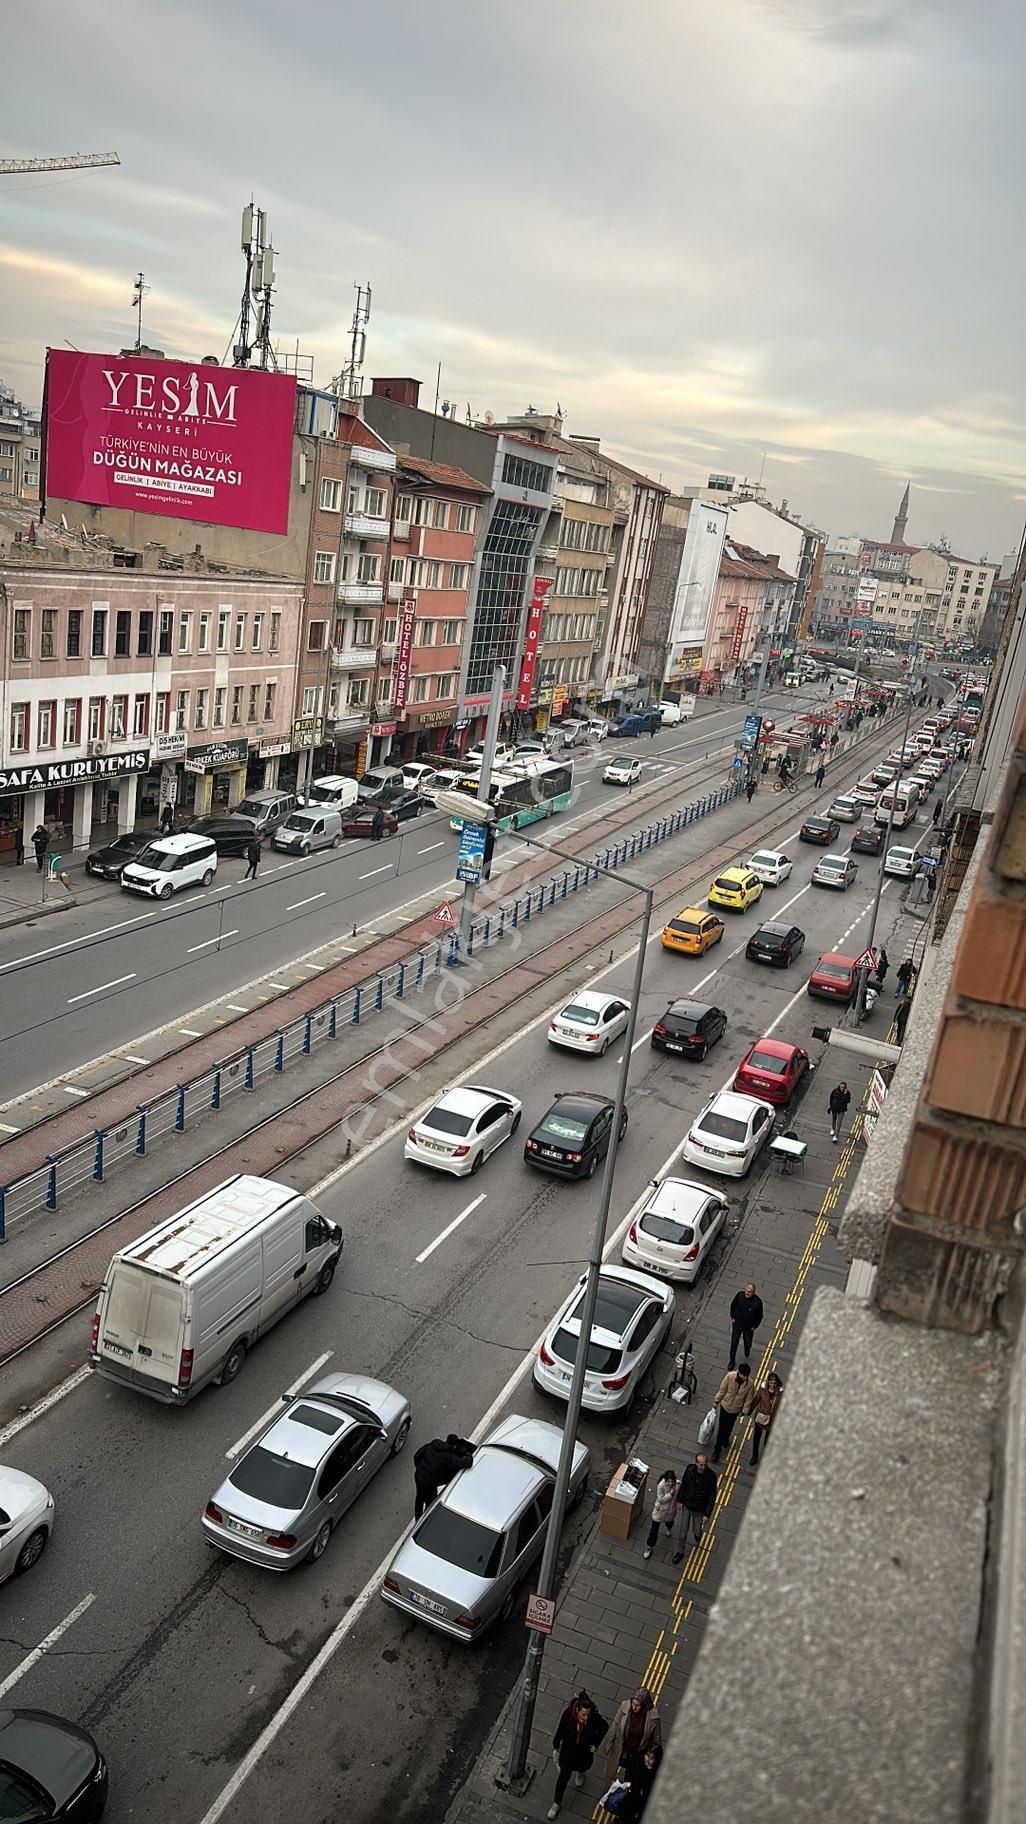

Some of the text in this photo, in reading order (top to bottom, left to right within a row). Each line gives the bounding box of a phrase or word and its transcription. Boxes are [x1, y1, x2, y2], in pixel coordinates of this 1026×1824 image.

[137, 421, 198, 437] KAYSERİ
[93, 449, 242, 486] DÜĞÜN MAĞAZASI
[100, 434, 233, 464] TÜRKİYE'NİN EN BÜYÜK
[178, 483, 212, 495] AYAKKABI
[396, 613, 414, 707] HOTEL ÖZBEK
[520, 608, 541, 704] HOTEL
[0, 752, 146, 789] SAFA KURUYEMİŞ
